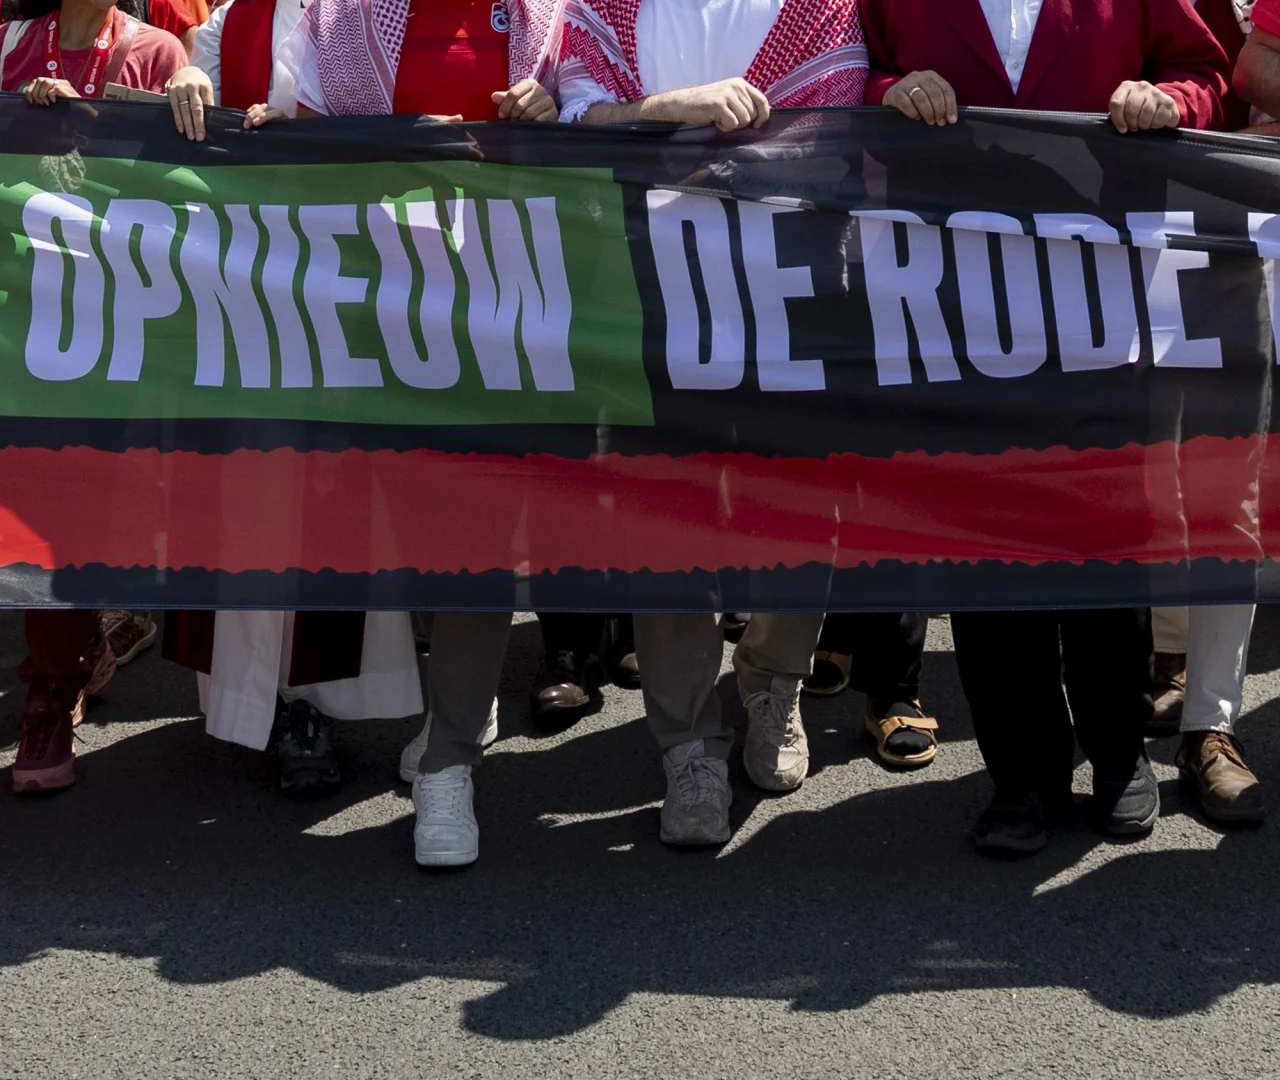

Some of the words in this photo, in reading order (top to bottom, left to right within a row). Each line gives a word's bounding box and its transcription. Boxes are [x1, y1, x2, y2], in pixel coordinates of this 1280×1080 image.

[21, 191, 576, 392] OPNIEUW
[646, 189, 826, 392] DE
[848, 210, 1223, 386] RODE
